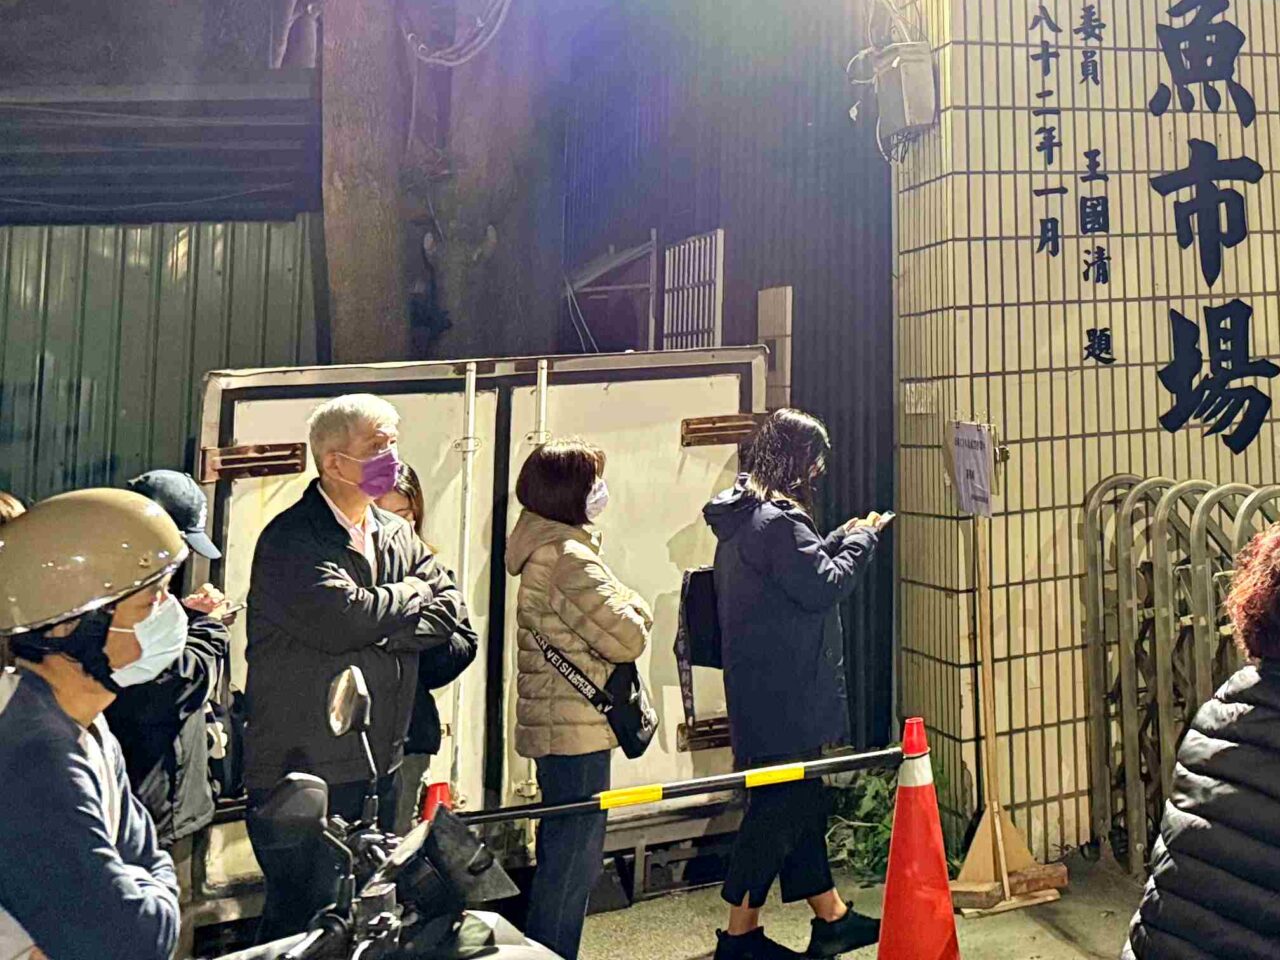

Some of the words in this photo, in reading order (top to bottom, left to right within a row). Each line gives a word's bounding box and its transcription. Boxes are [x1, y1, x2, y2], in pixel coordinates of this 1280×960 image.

[1080, 149, 1111, 285] 王國清
[1083, 327, 1117, 365] 題
